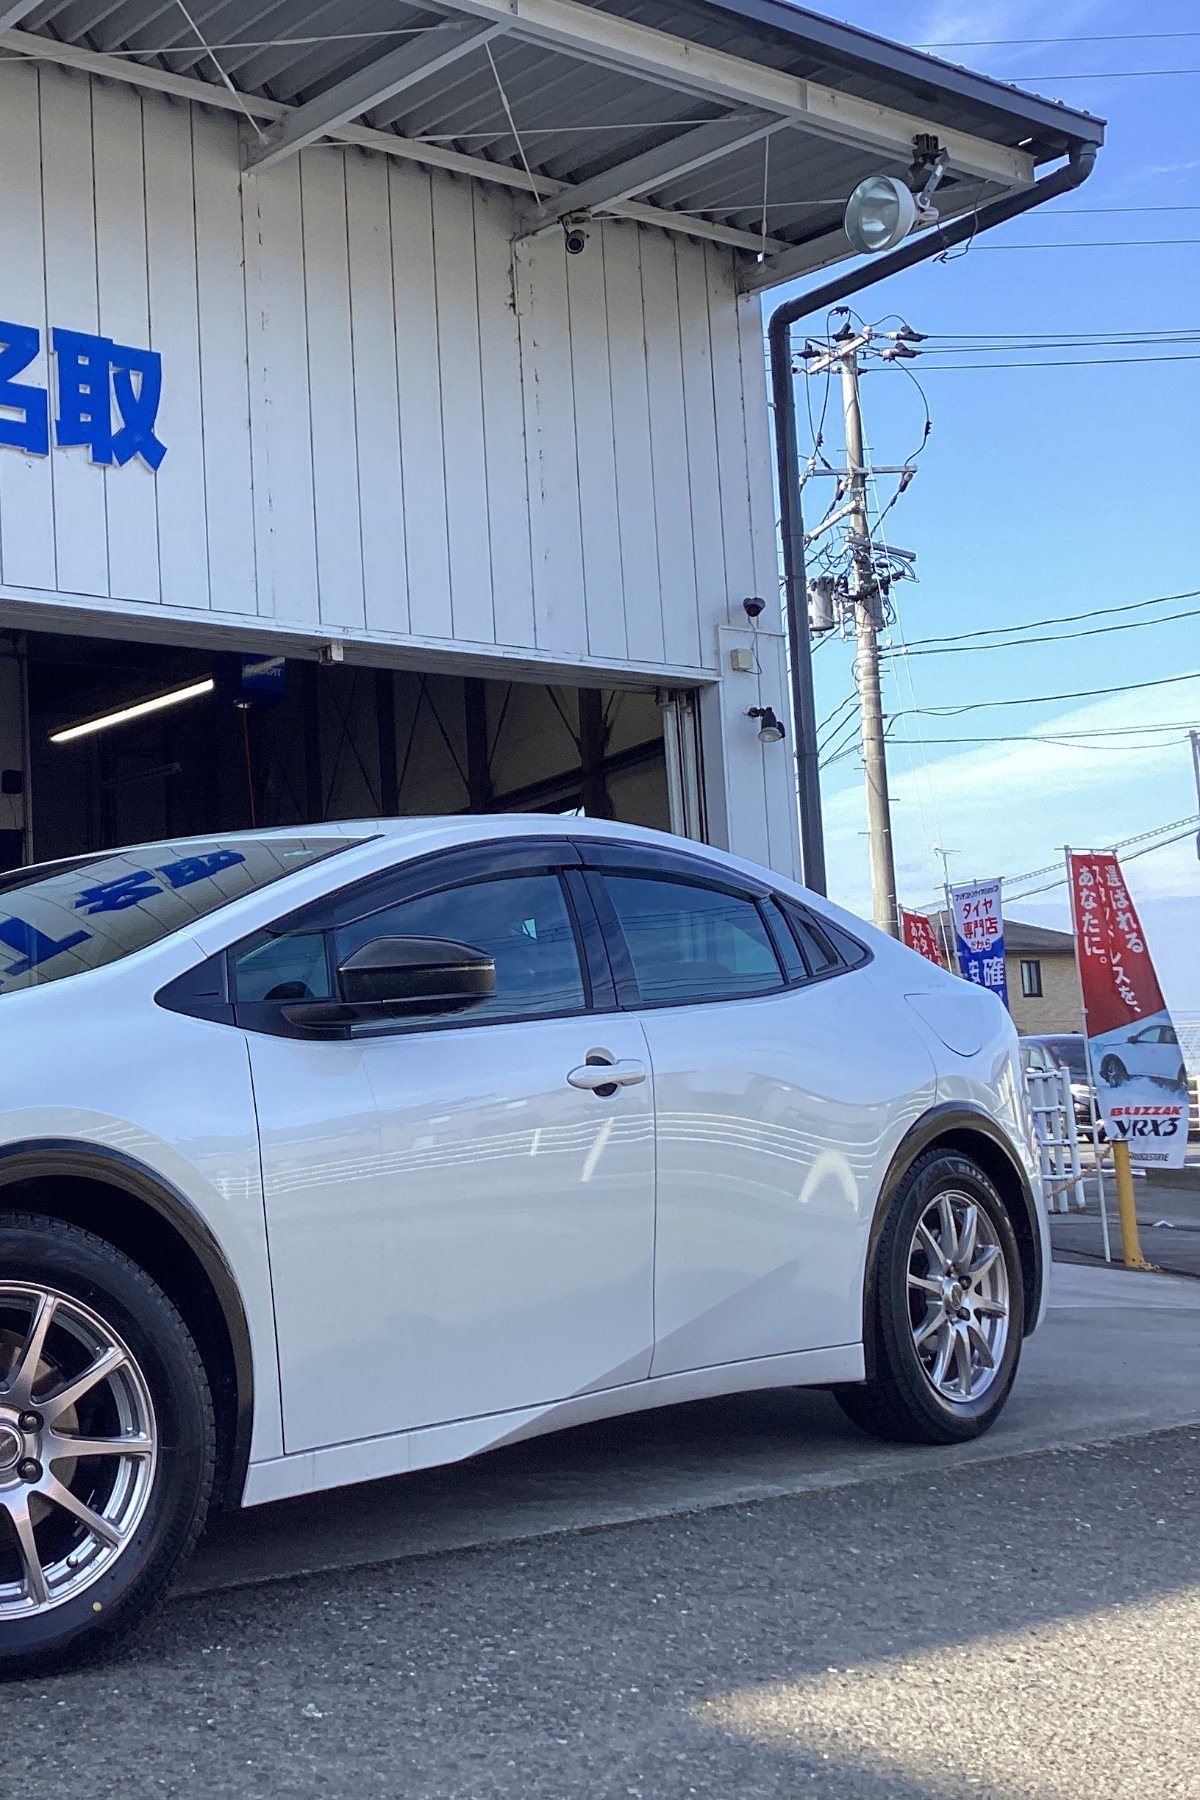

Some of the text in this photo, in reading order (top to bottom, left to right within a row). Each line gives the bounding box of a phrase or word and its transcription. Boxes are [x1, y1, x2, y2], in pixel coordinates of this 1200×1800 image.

[962, 898, 993, 920] タイヤ
[1078, 865, 1108, 964] あなたに。
[1105, 864, 1144, 954] 選ばれる
[962, 916, 999, 940] 専門店
[1110, 1105, 1184, 1117] BLIZZAK
[1113, 1117, 1181, 1137] VRX3
